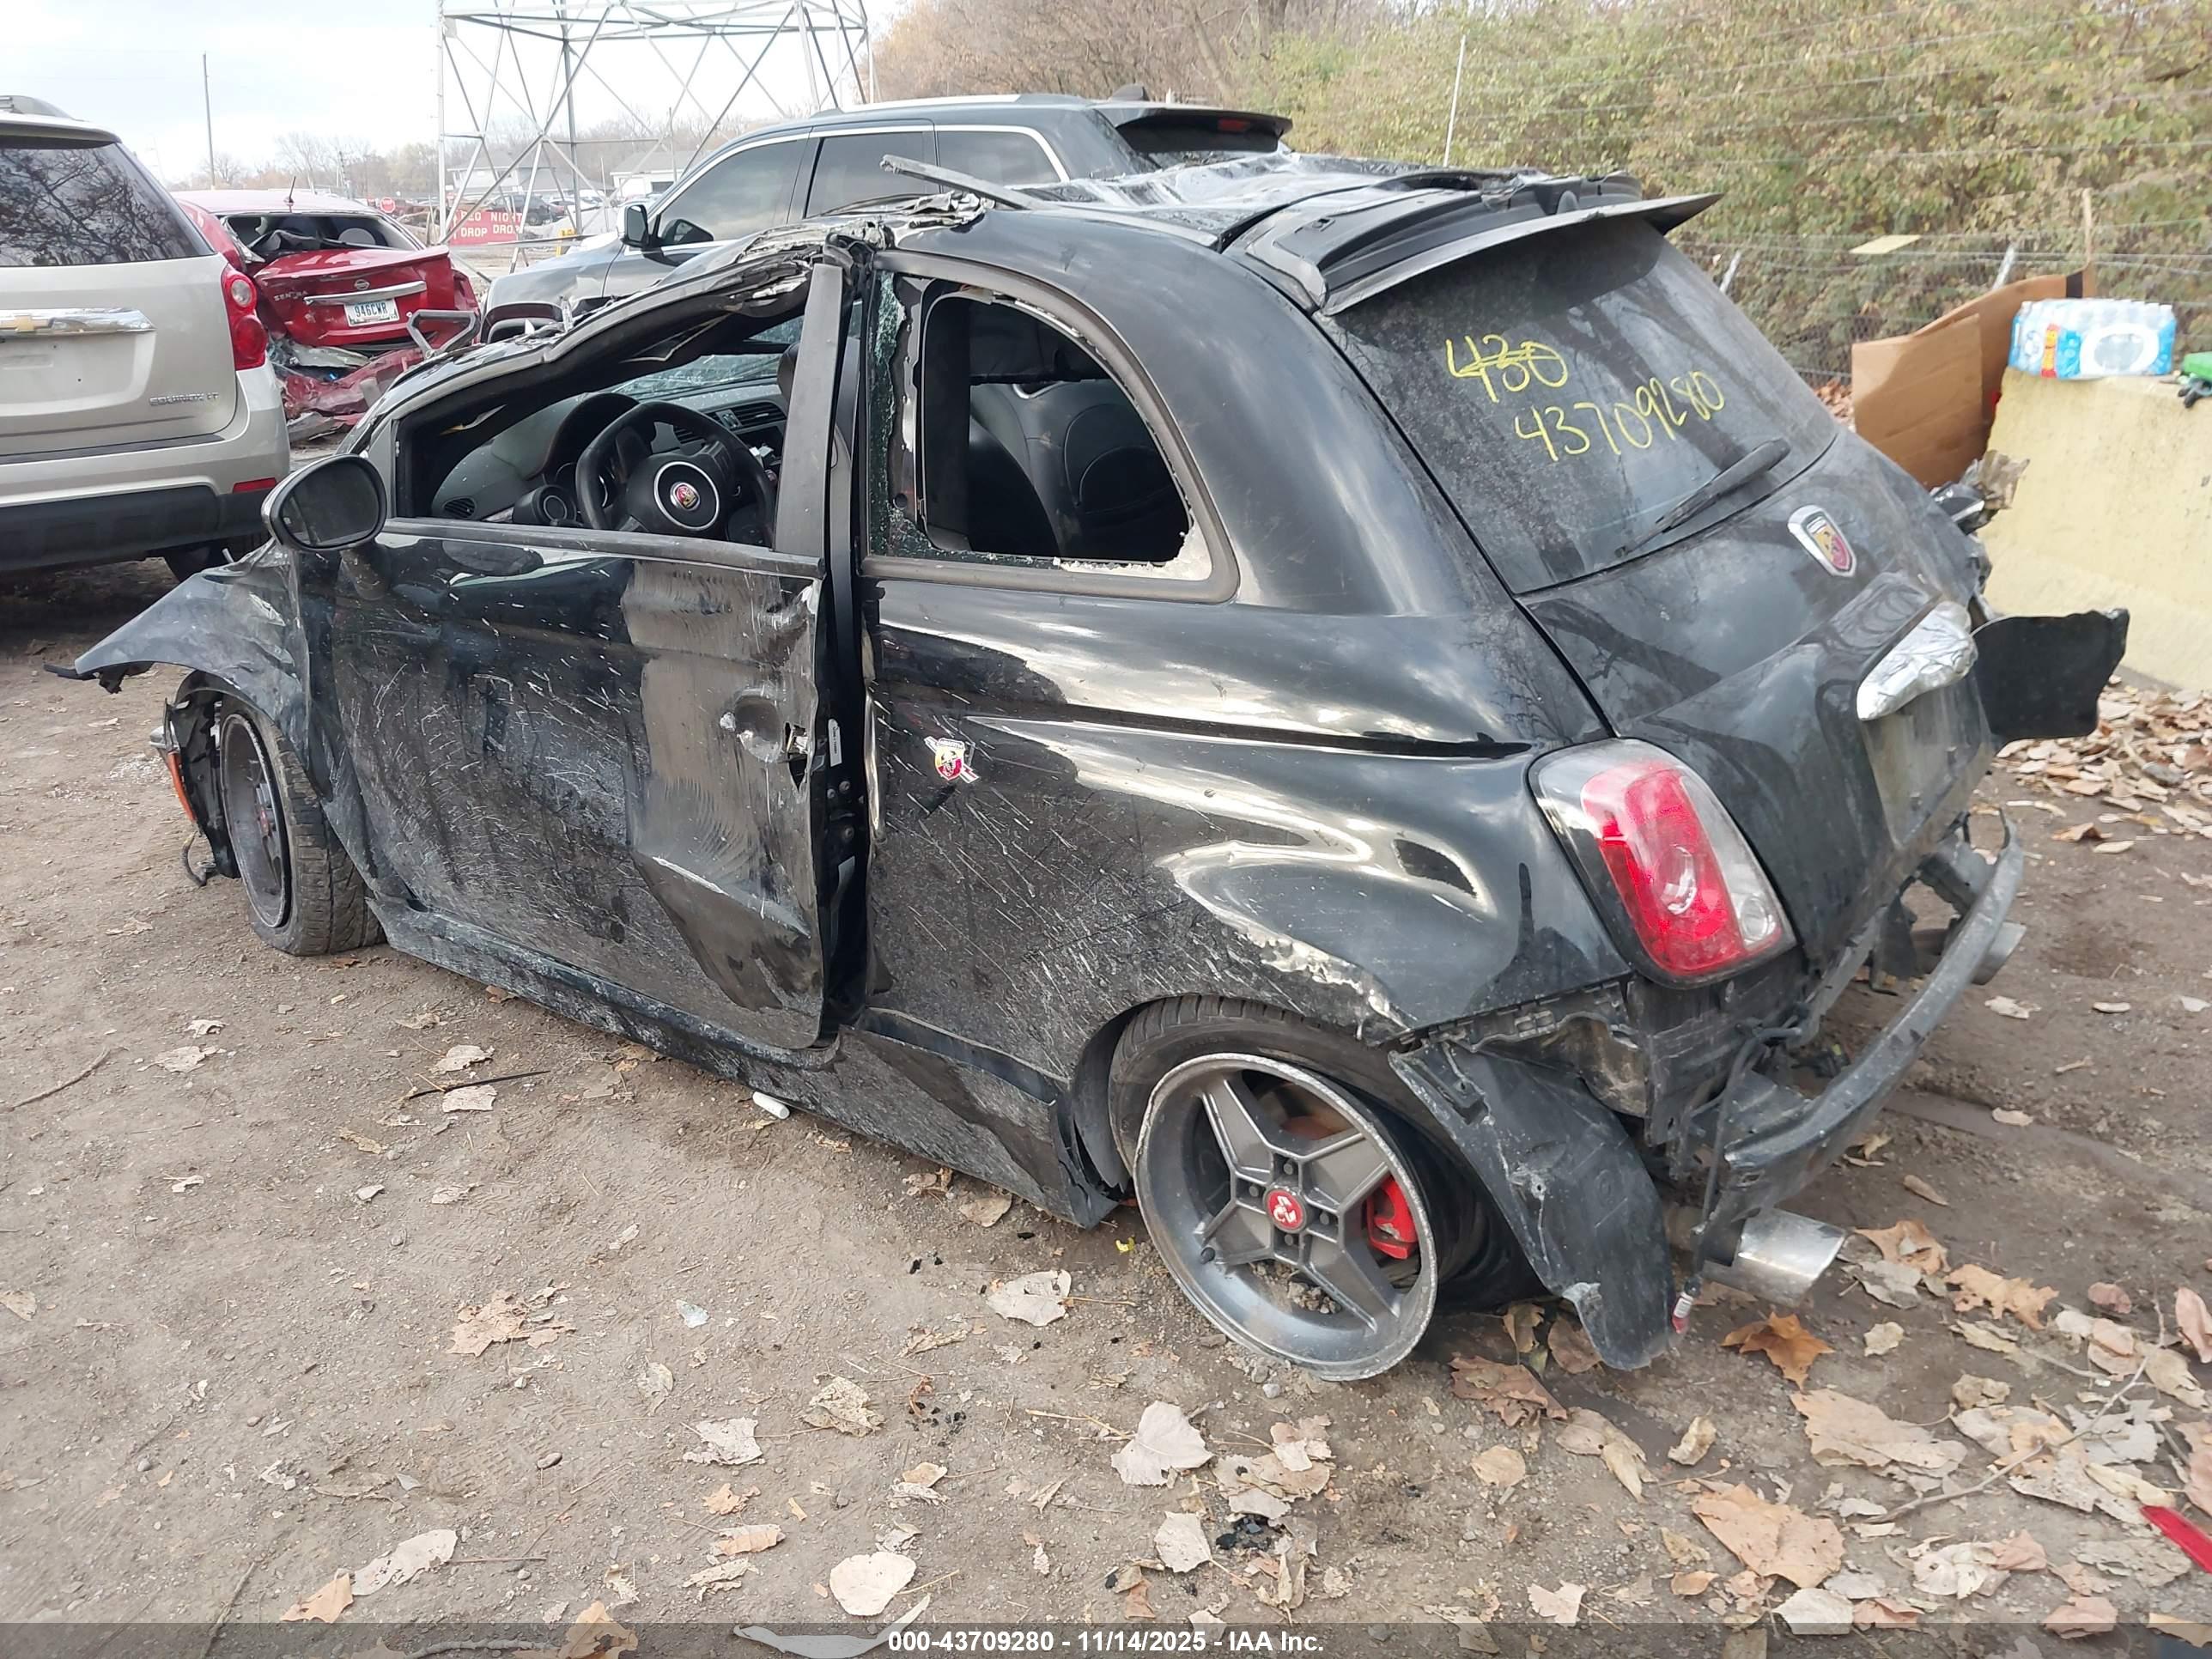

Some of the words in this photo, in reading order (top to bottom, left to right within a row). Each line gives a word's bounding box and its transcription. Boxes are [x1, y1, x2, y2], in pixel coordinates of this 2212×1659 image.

[460, 227, 488, 237] DROP
[354, 301, 388, 318] 946CWR
[1514, 370, 1725, 462] 43709280
